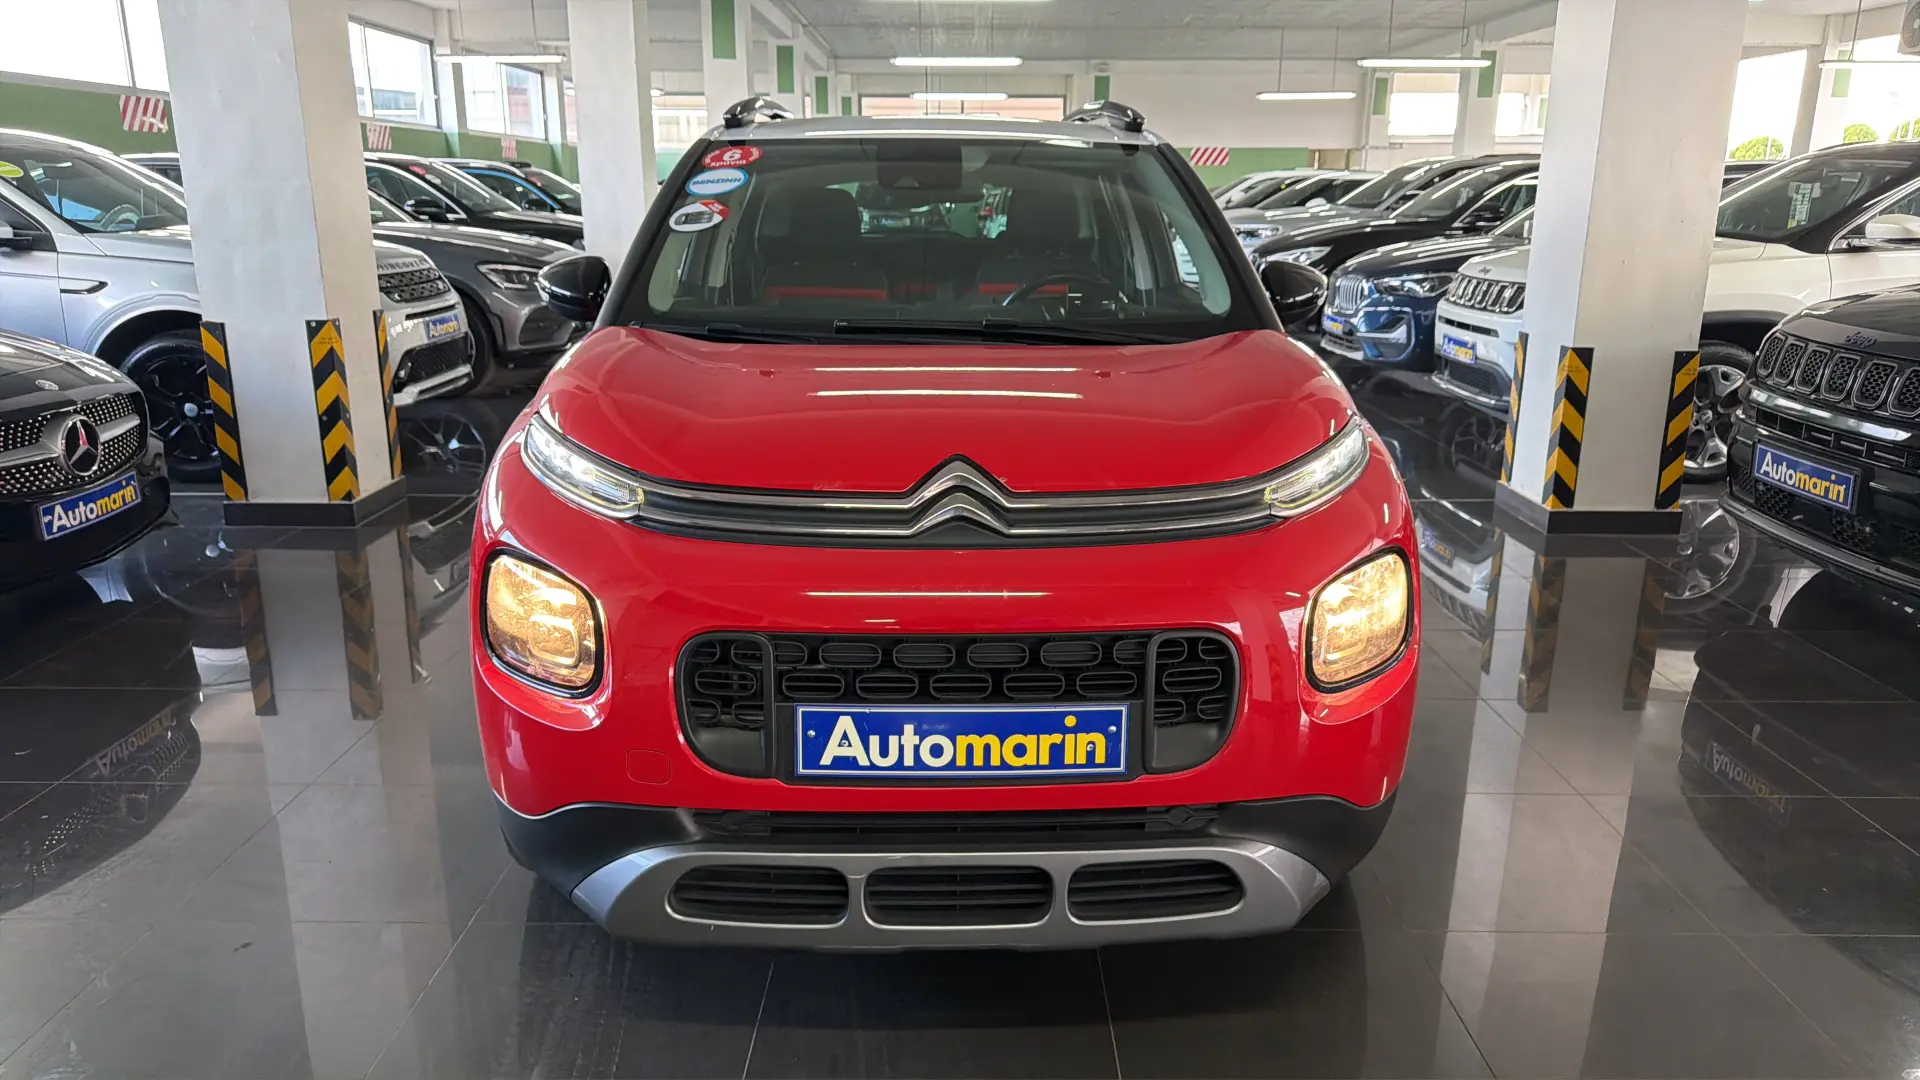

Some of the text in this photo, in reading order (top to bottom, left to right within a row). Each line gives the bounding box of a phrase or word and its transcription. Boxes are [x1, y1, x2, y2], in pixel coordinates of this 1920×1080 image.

[723, 149, 743, 161] 6
[1760, 452, 1846, 503] Automarin
[53, 480, 136, 533] Automarin
[819, 715, 1106, 767] Automarin
